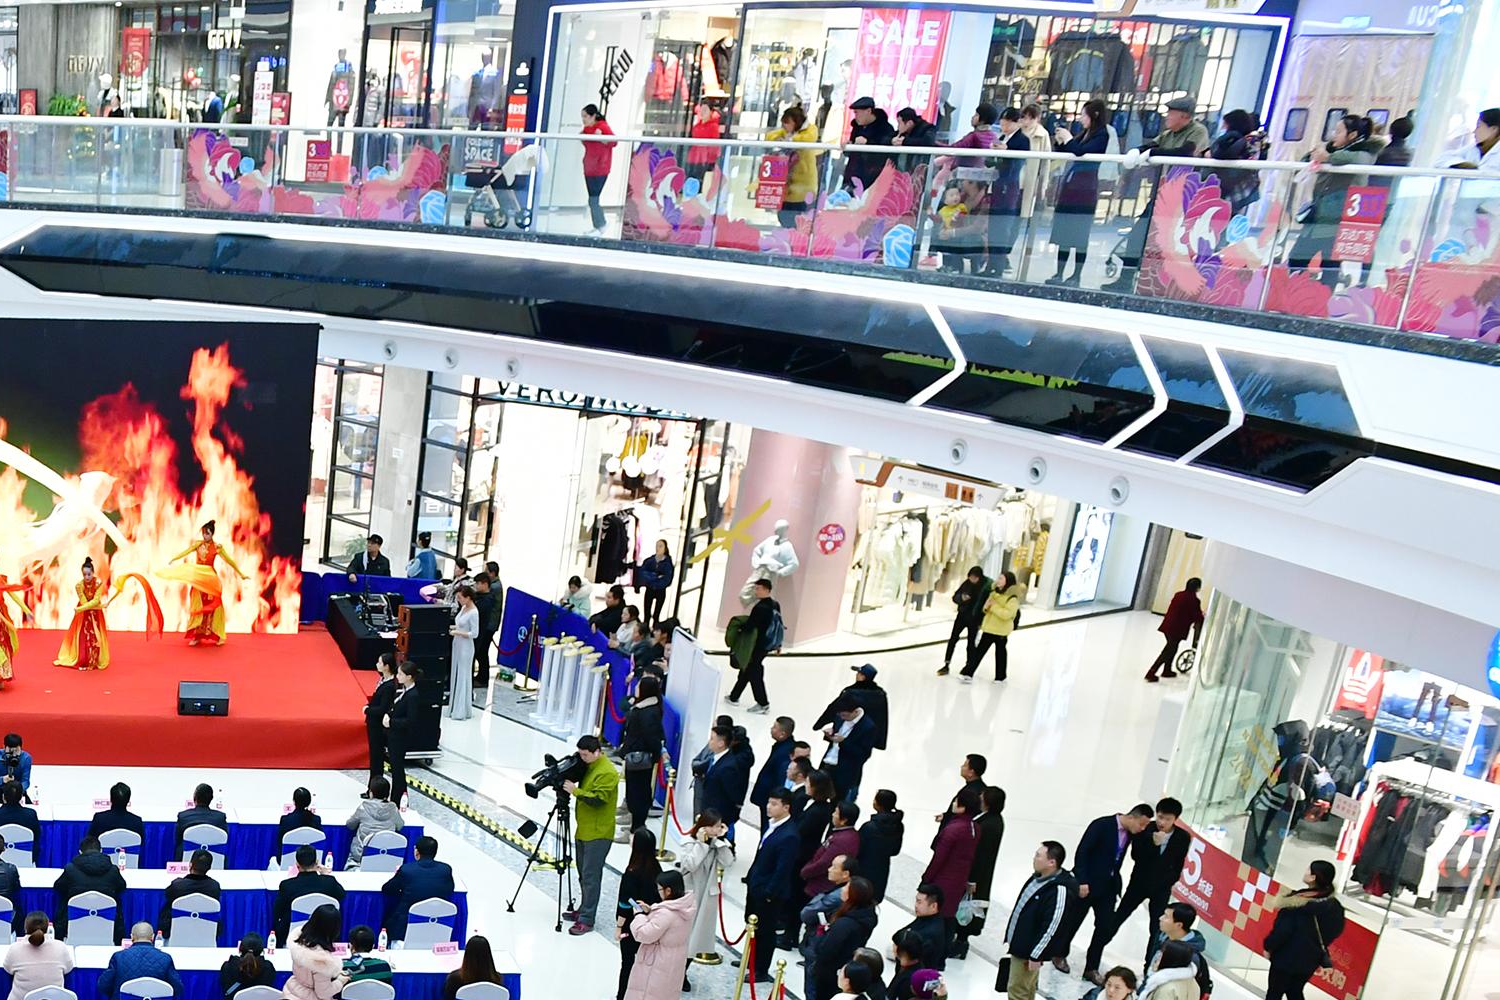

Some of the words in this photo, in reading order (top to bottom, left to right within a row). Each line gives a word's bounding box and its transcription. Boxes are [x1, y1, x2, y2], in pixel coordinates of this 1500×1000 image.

[866, 17, 941, 47] SALE
[464, 148, 494, 162] SPACE
[1182, 837, 1206, 886] 5
